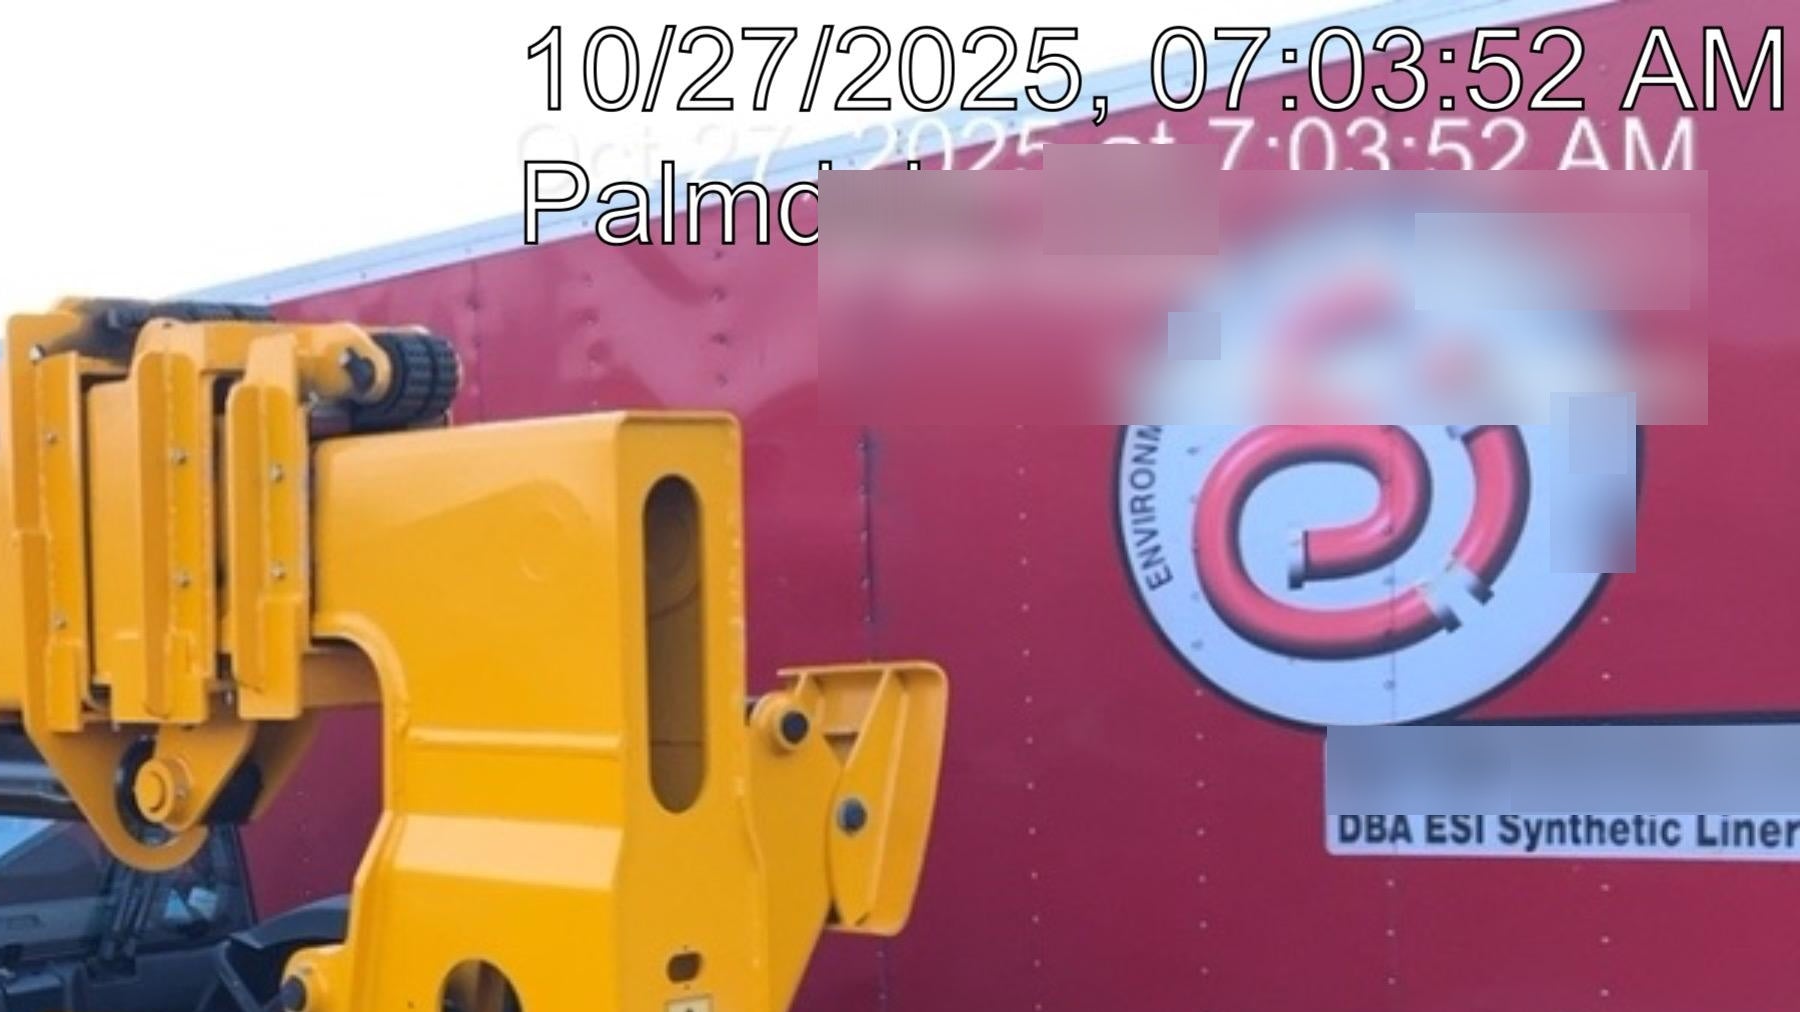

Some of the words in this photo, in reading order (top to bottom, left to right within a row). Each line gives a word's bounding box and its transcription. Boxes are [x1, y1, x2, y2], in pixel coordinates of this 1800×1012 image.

[1338, 814, 1413, 844] DBA
[1425, 814, 1484, 845] ESI
[1500, 814, 1681, 852] Synthetic
